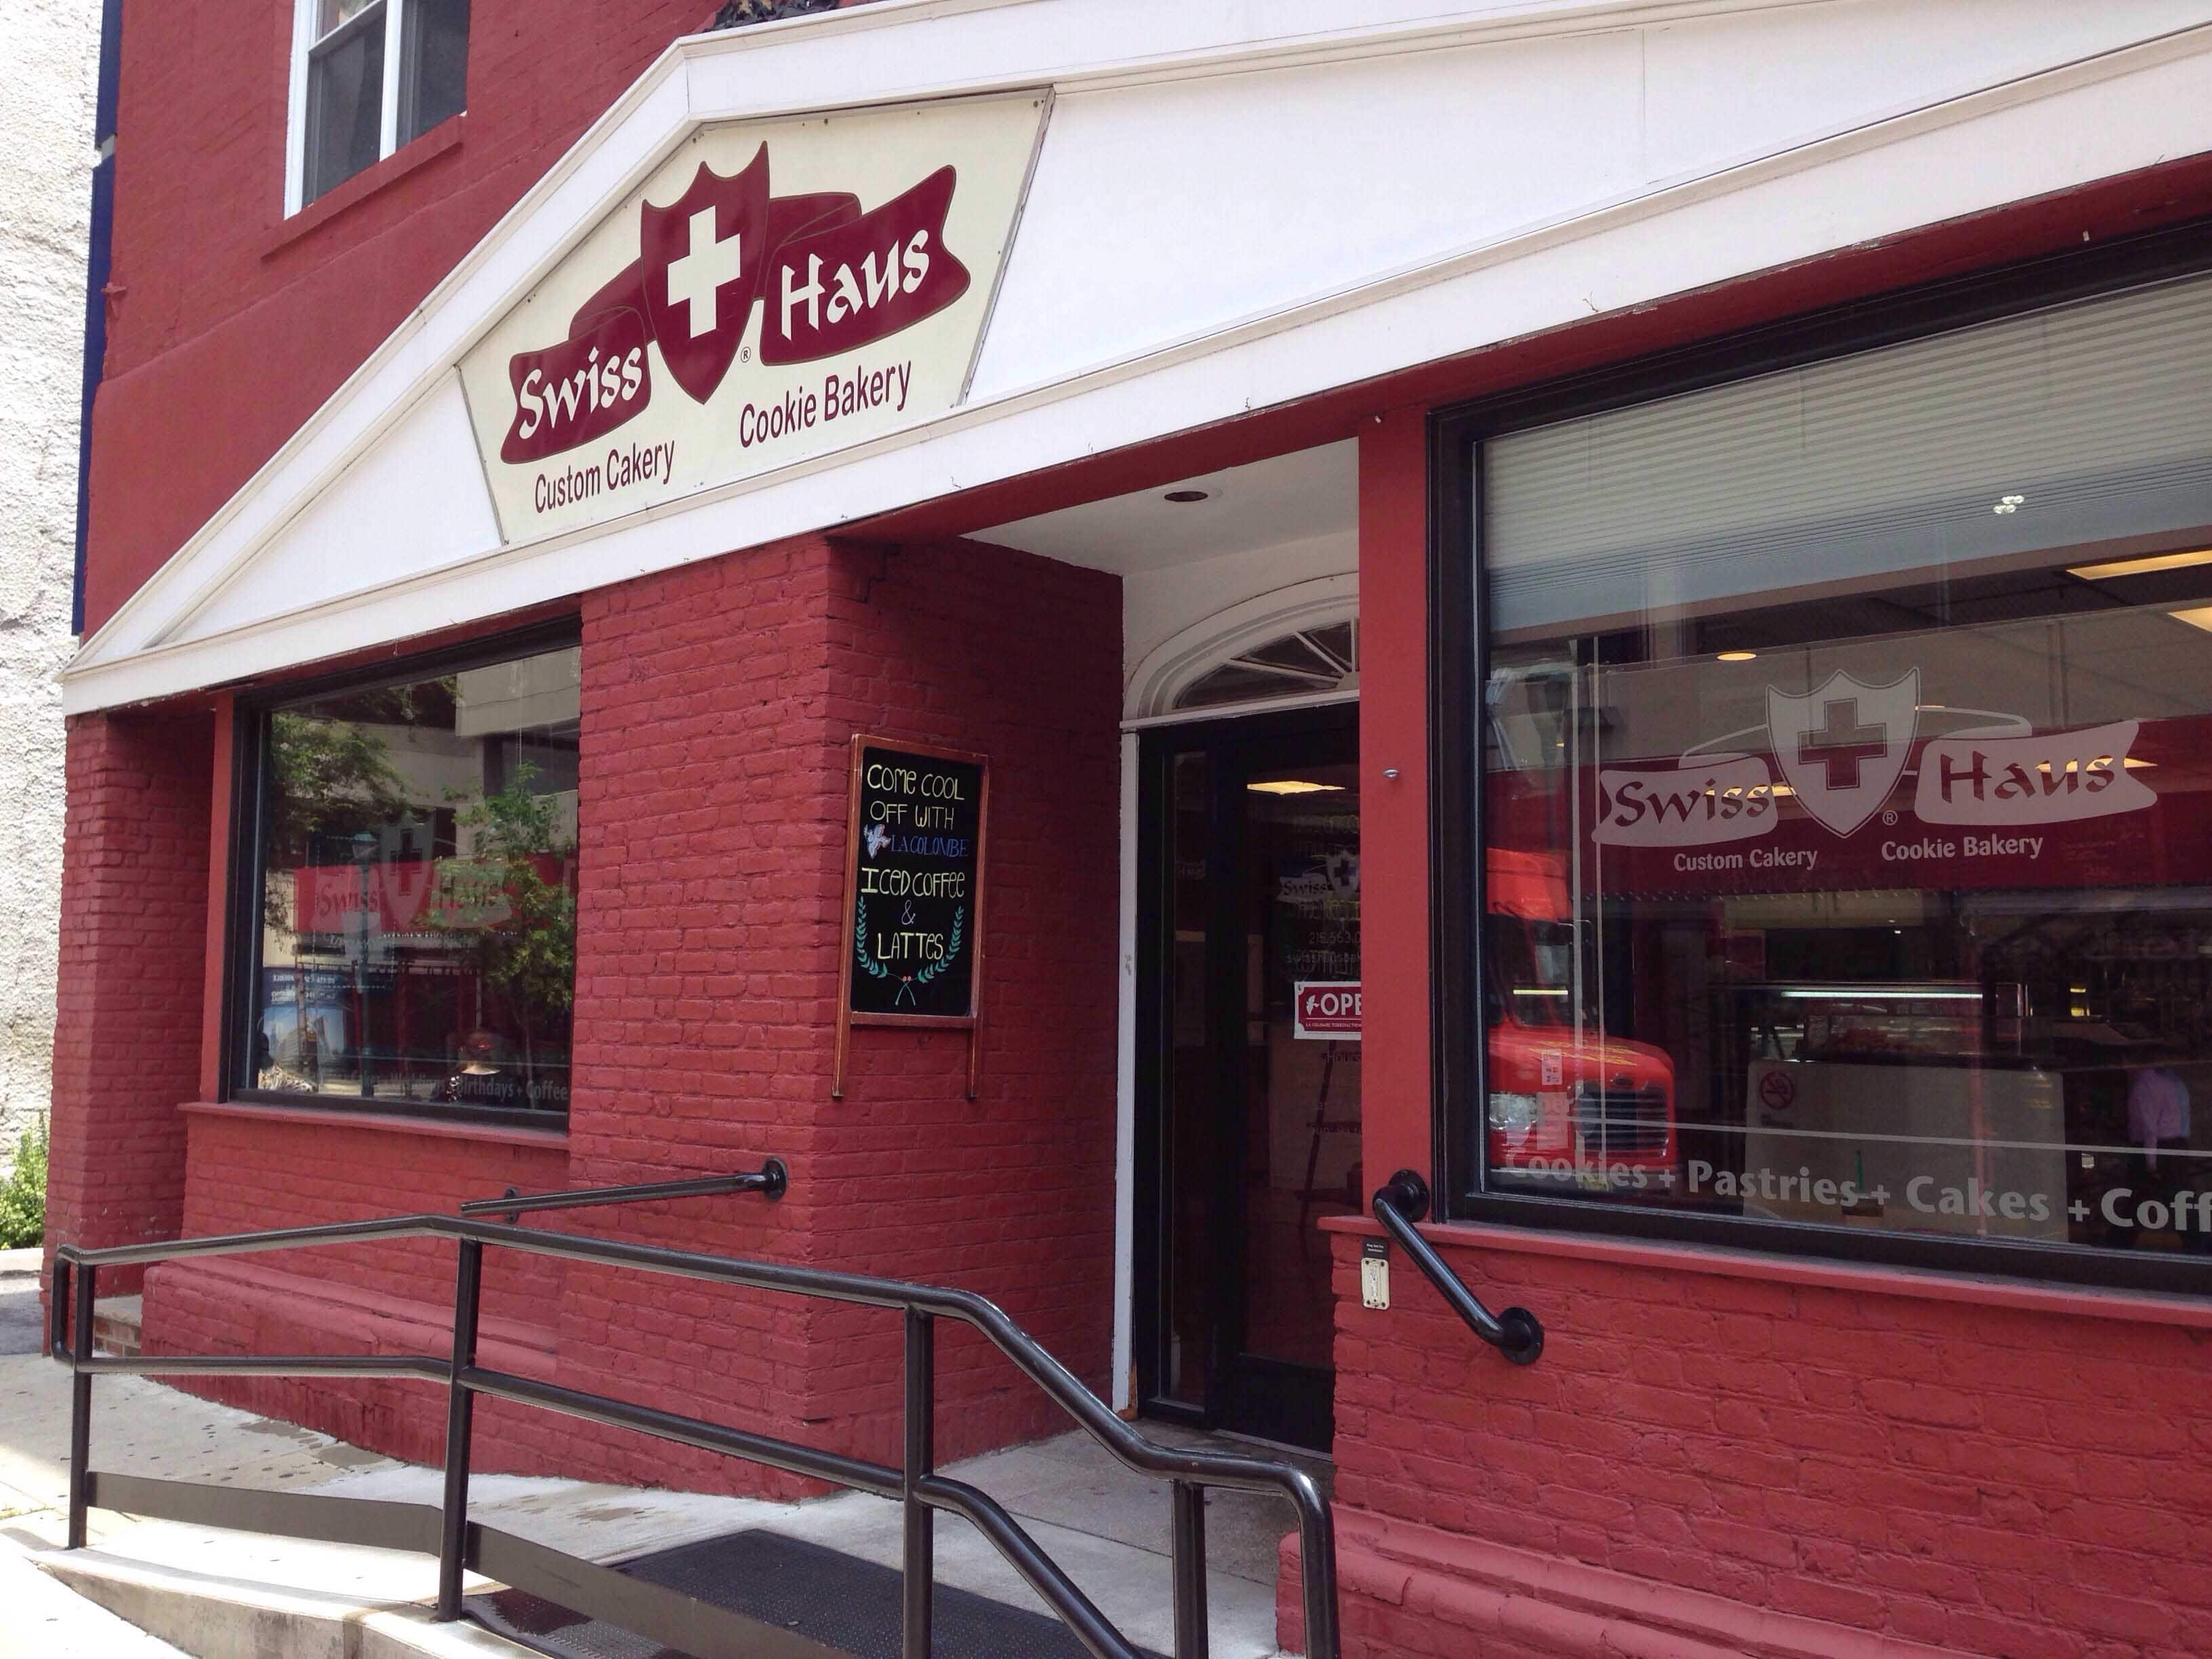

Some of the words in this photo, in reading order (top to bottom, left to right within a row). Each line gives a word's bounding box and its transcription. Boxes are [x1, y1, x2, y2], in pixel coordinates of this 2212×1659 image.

[519, 346, 642, 440] Swiss
[781, 228, 930, 341] Haus
[740, 385, 816, 448] Cookie
[825, 360, 912, 422] Bakery
[535, 464, 601, 513] Custom
[607, 440, 675, 491] Cakery
[870, 800, 907, 825] OFF
[915, 805, 955, 830] WITH
[921, 773, 965, 801] COOL
[1615, 777, 1770, 827] Swiss
[1940, 750, 2114, 804] Haus
[1673, 851, 1743, 873] Custom
[1748, 846, 1819, 871] Cakery
[1881, 838, 1955, 862] Cookie
[1963, 833, 2044, 858] Bakery
[1506, 1150, 1647, 1187] Cookies
[1689, 1160, 1858, 1207] Pastries
[1906, 1176, 2048, 1222] Cakes
